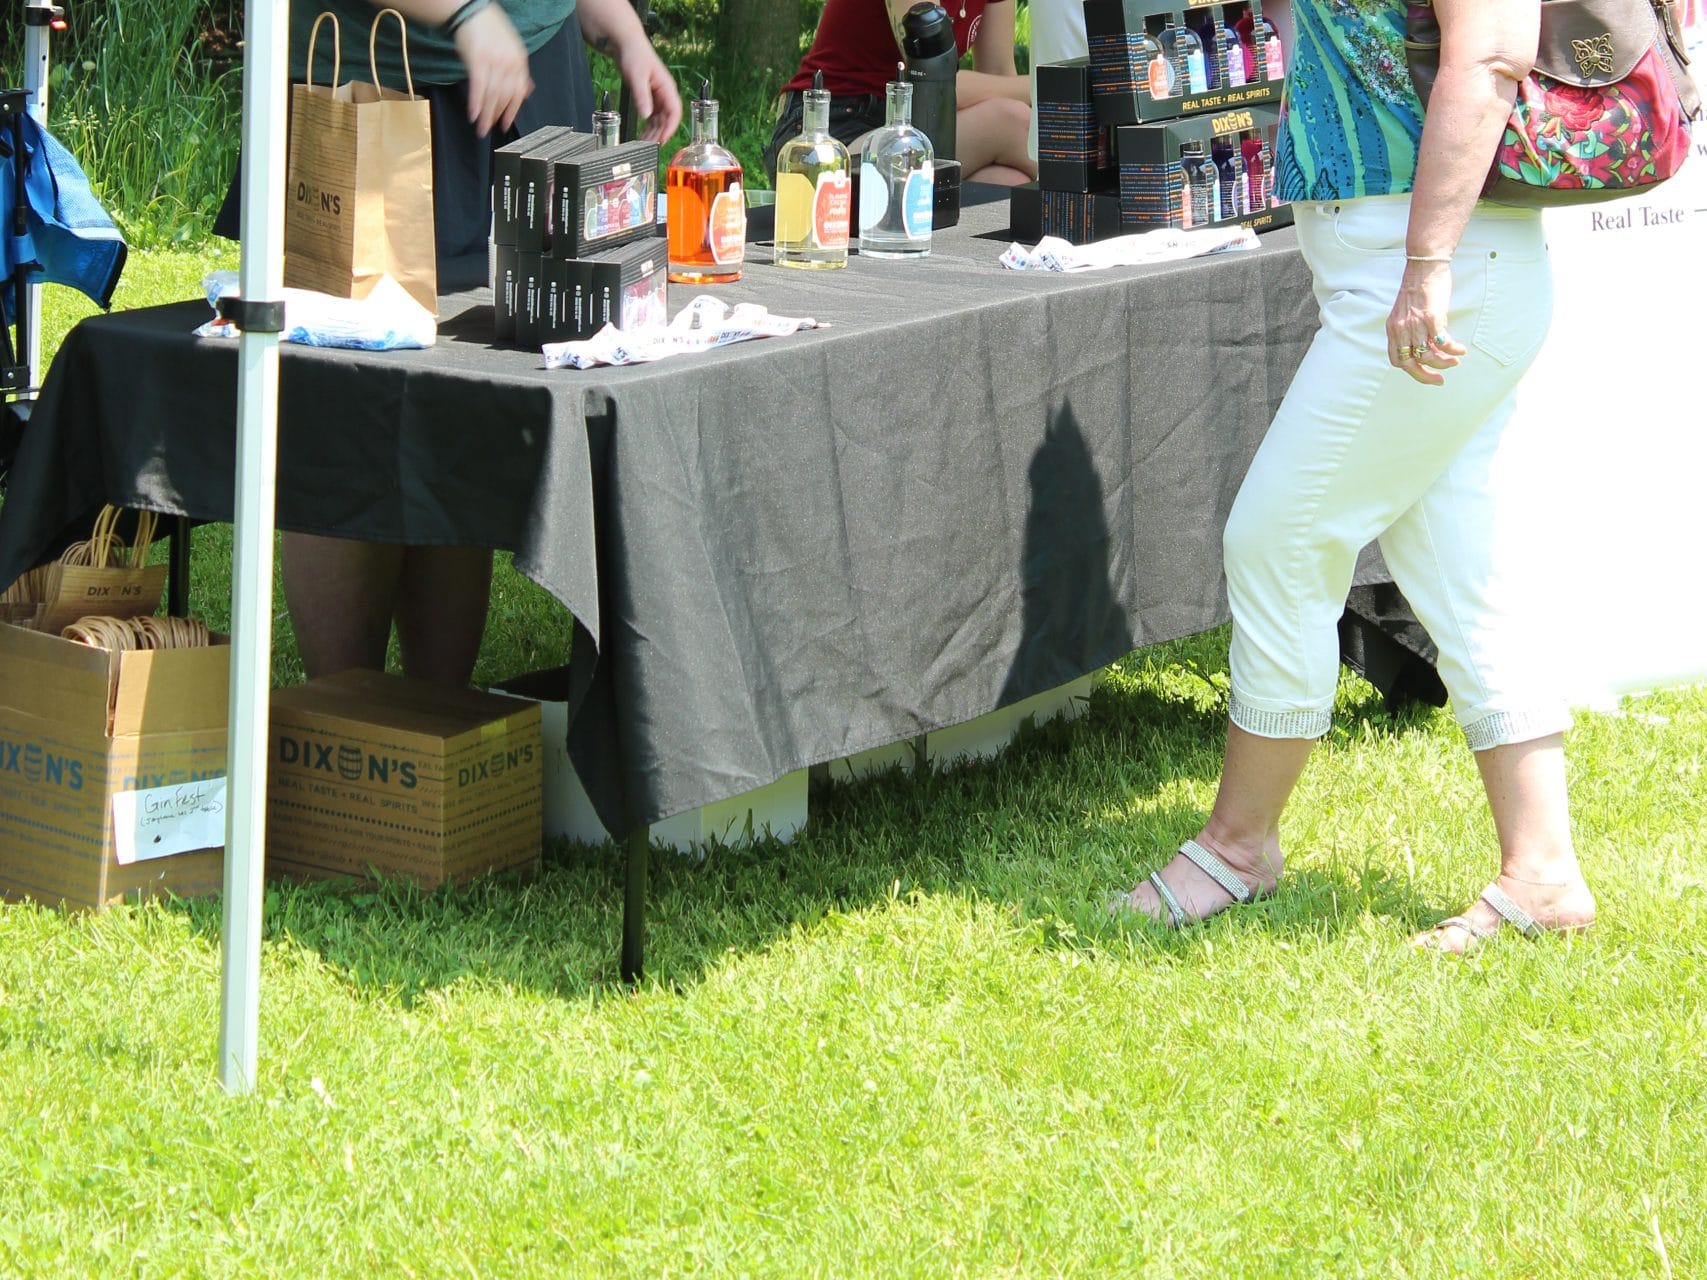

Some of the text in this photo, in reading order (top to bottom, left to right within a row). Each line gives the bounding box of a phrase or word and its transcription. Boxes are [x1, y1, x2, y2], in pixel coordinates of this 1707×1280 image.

[1183, 87, 1271, 111] REAL TASTE REAL SPIRITS
[1591, 205, 1684, 232] Real Taste
[350, 792, 375, 807] REAL
[380, 798, 417, 815] SPIRITS
